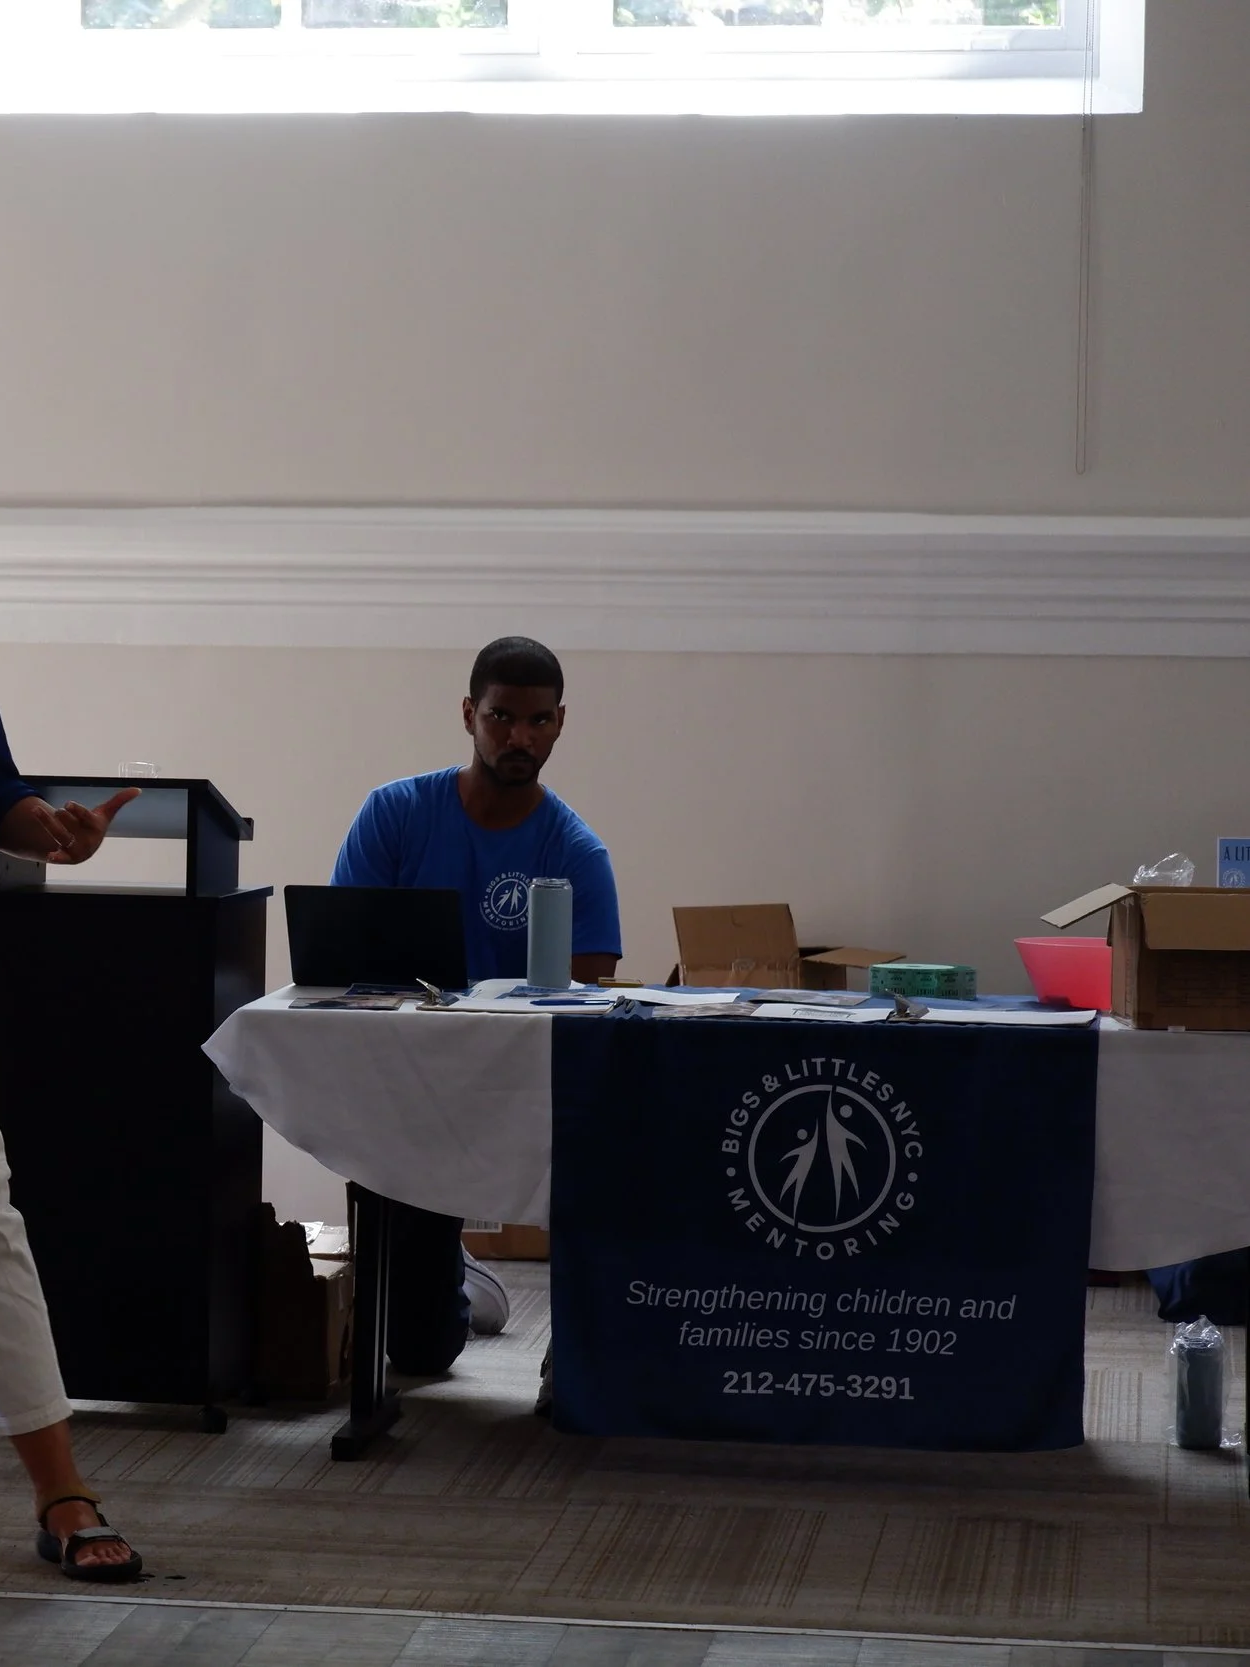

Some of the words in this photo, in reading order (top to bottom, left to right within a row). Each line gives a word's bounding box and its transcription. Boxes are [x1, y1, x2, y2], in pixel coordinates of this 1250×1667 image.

[1224, 846, 1231, 861] A
[721, 1091, 761, 1154] BIGS
[761, 1074, 781, 1092] &
[727, 1187, 915, 1260] MENTORING
[626, 1280, 827, 1318] Strengthening
[836, 1287, 951, 1317] children
[959, 1294, 1017, 1320] and
[679, 1321, 790, 1348] families
[798, 1324, 876, 1351] since
[886, 1328, 958, 1356] 1902
[722, 1370, 915, 1400] 212-475-3291
